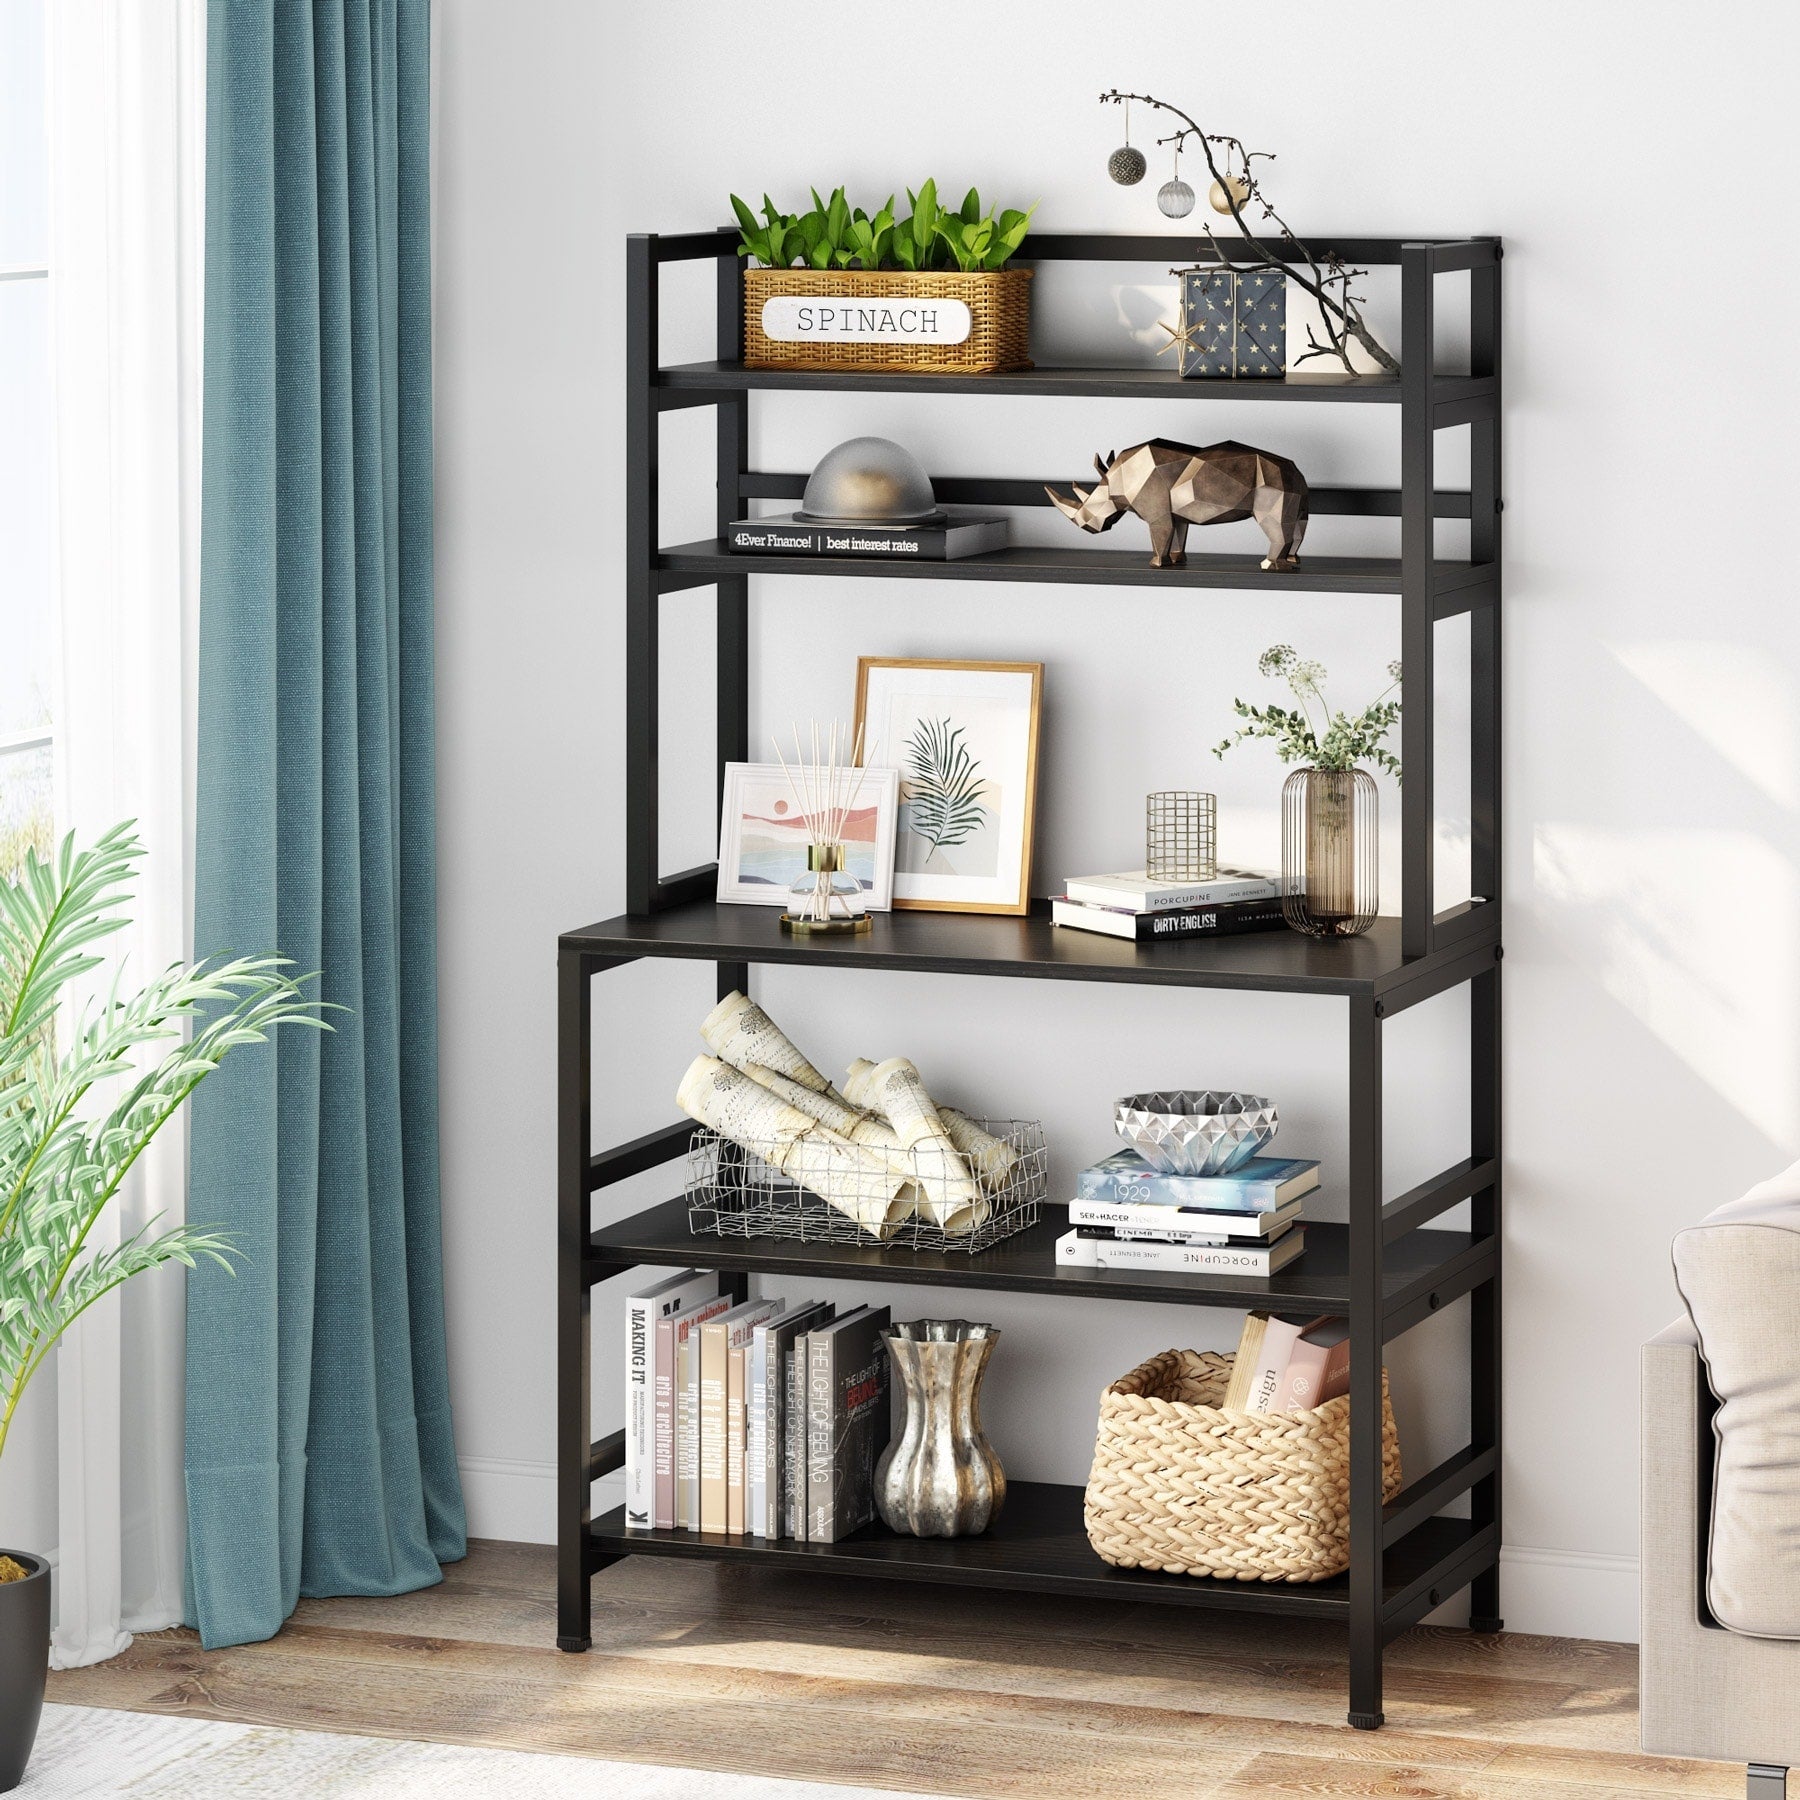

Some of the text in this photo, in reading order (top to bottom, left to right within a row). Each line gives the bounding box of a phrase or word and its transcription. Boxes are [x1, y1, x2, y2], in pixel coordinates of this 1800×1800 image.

[797, 307, 939, 333] SPINACH
[734, 533, 812, 549] 4Ever Finance!
[826, 536, 919, 553] best interest rates
[1153, 893, 1211, 906] PORCUPINE
[1153, 913, 1217, 934] DIRTY ENGLISH
[1113, 1183, 1151, 1202] 1929
[1109, 1249, 1161, 1259] JANE BENNETT
[1183, 1252, 1259, 1267] PORCUPINE
[631, 1308, 646, 1385] MAKING IT
[656, 1375, 672, 1396] arts
[687, 1382, 699, 1403] arts
[728, 1398, 743, 1417] arts
[766, 1337, 776, 1468] THE LIGHT OF PARIS
[787, 1382, 796, 1413] LIGHT
[796, 1398, 804, 1413] OF
[812, 1339, 829, 1483] THE LIGHT OF BEIJING
[701, 1379, 726, 1479] arts & architecture
[796, 1414, 804, 1438] SAN
[656, 1413, 673, 1475] architecture
[687, 1418, 699, 1480] architecture
[728, 1431, 744, 1487] architecture
[796, 1438, 804, 1500] FRANCISCO
[787, 1462, 796, 1498] YORK
[628, 1510, 648, 1523] K
